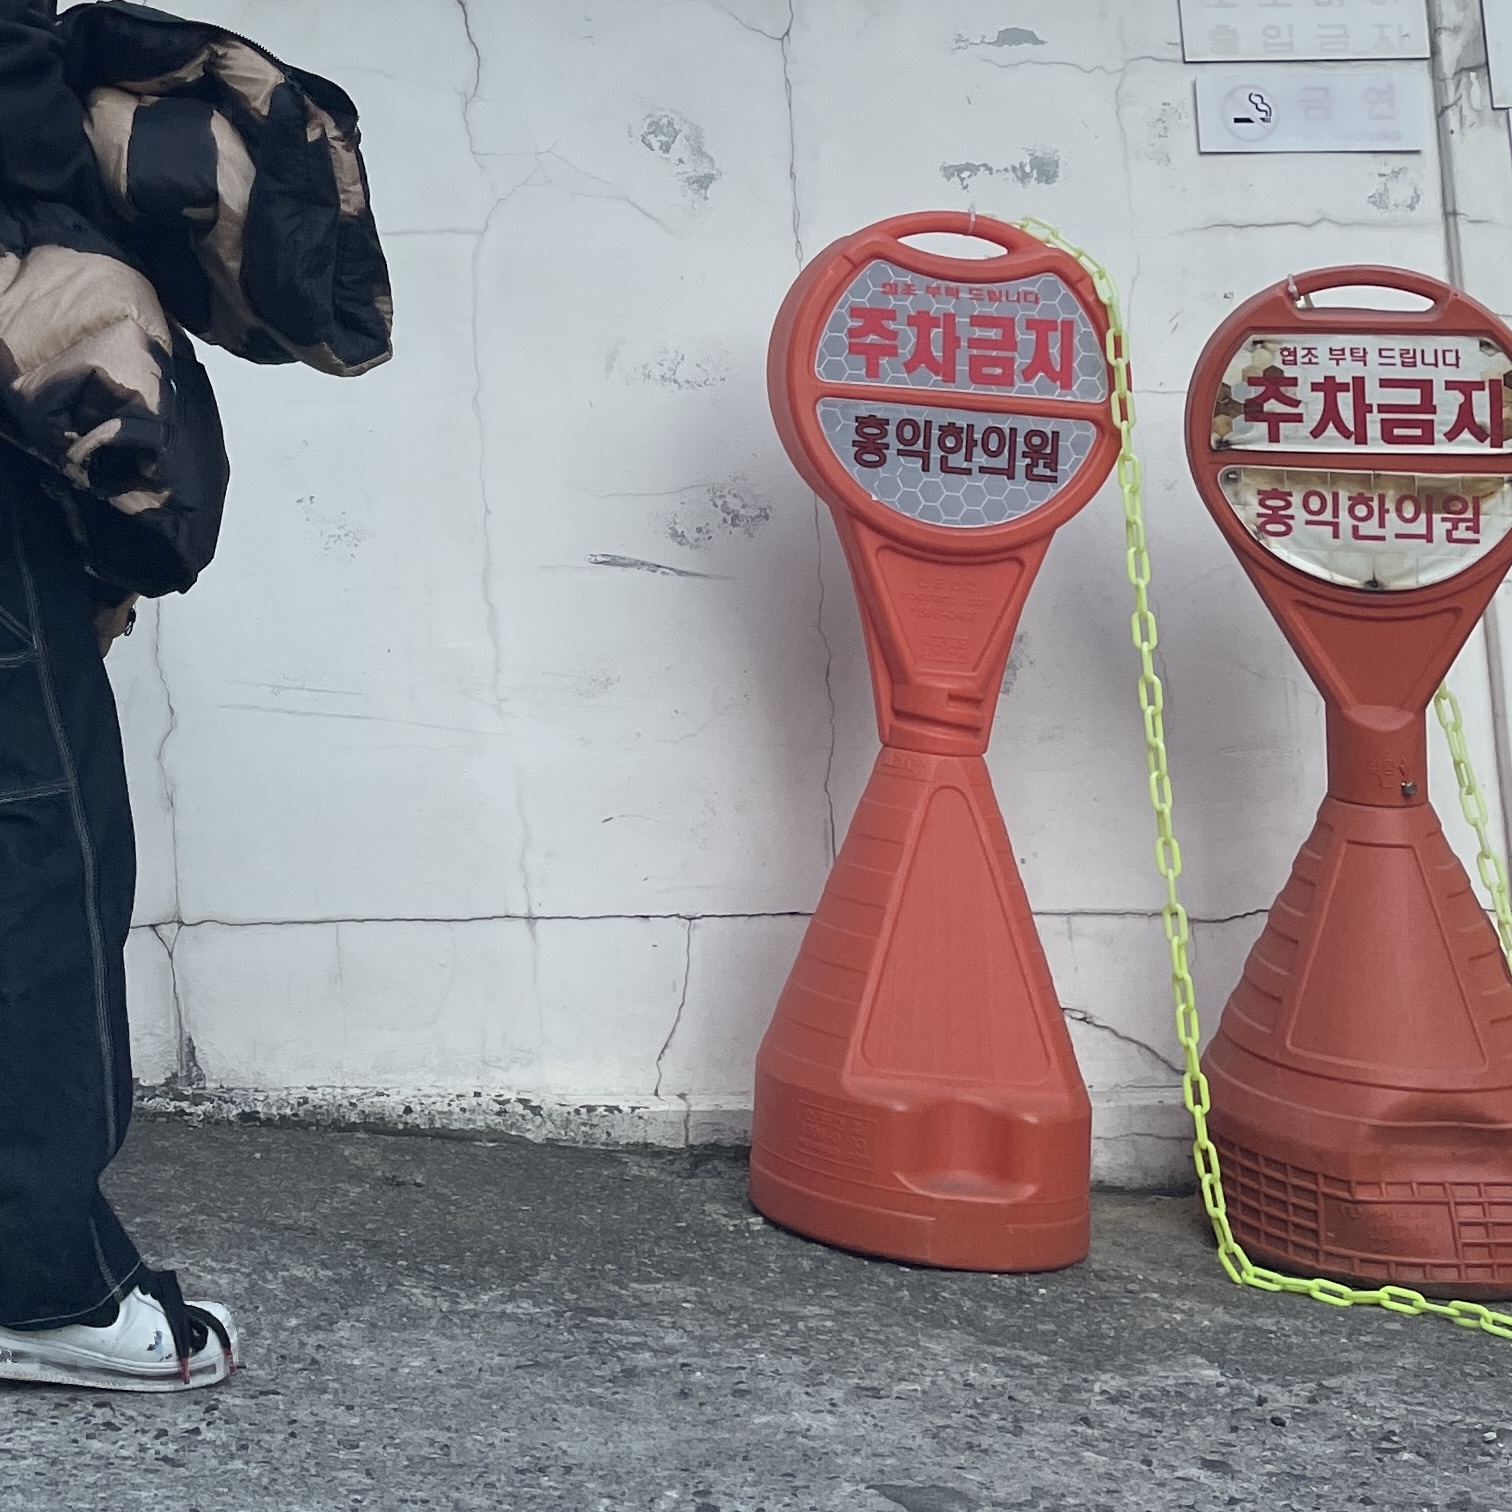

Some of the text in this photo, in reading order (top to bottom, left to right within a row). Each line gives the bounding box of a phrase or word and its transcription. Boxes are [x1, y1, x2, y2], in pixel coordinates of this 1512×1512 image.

[968, 288, 1041, 305] 드립니다
[848, 306, 1074, 390] 주차금지
[1279, 346, 1461, 368] 협조 부탁 드립니다
[1244, 375, 1504, 449] 주차금지
[852, 414, 1061, 483] 홍익한의원
[1256, 488, 1481, 544] 홍익한의원
